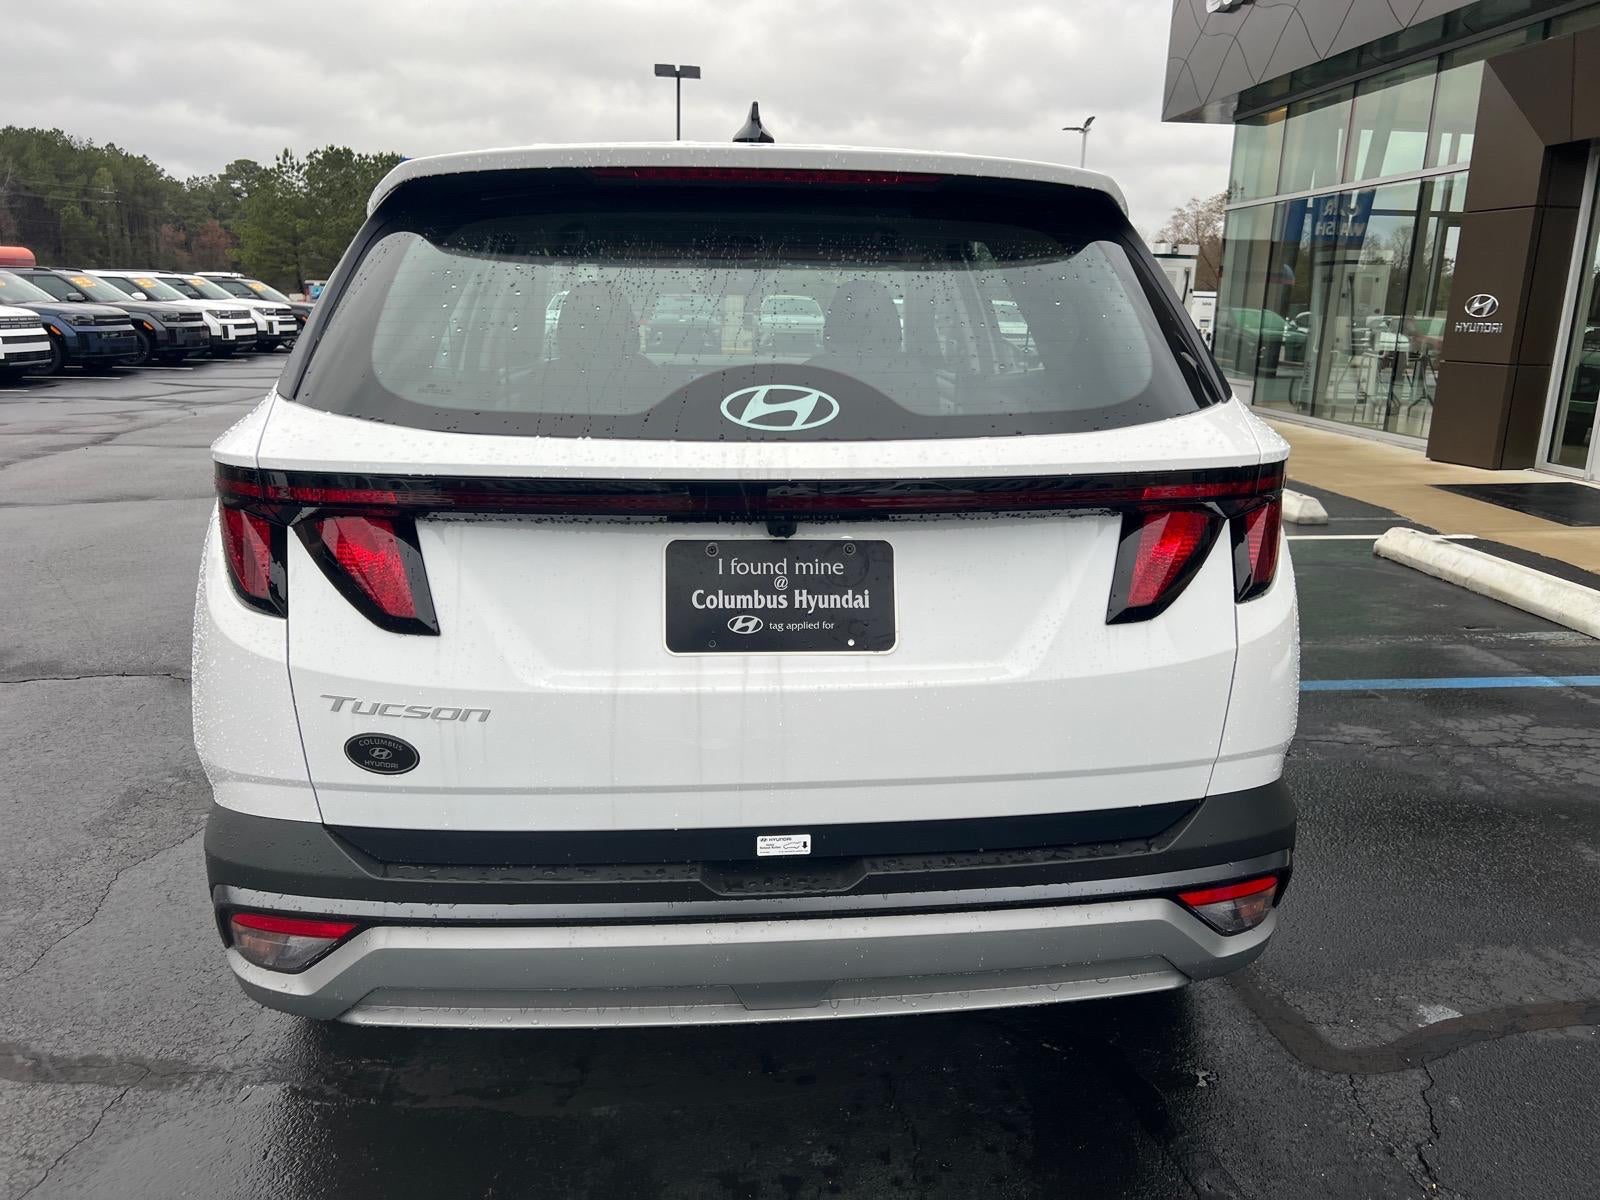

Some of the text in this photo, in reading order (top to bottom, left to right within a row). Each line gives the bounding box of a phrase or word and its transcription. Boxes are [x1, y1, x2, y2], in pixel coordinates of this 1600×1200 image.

[1454, 322, 1504, 334] HYUNDAI
[718, 557, 845, 575] I found mine
[773, 576, 789, 591] @
[691, 589, 870, 614] Columbus Hyundai
[768, 621, 835, 632] tag applied for
[358, 738, 405, 751] COLUMBUS
[364, 760, 399, 769] HYUNDAI
